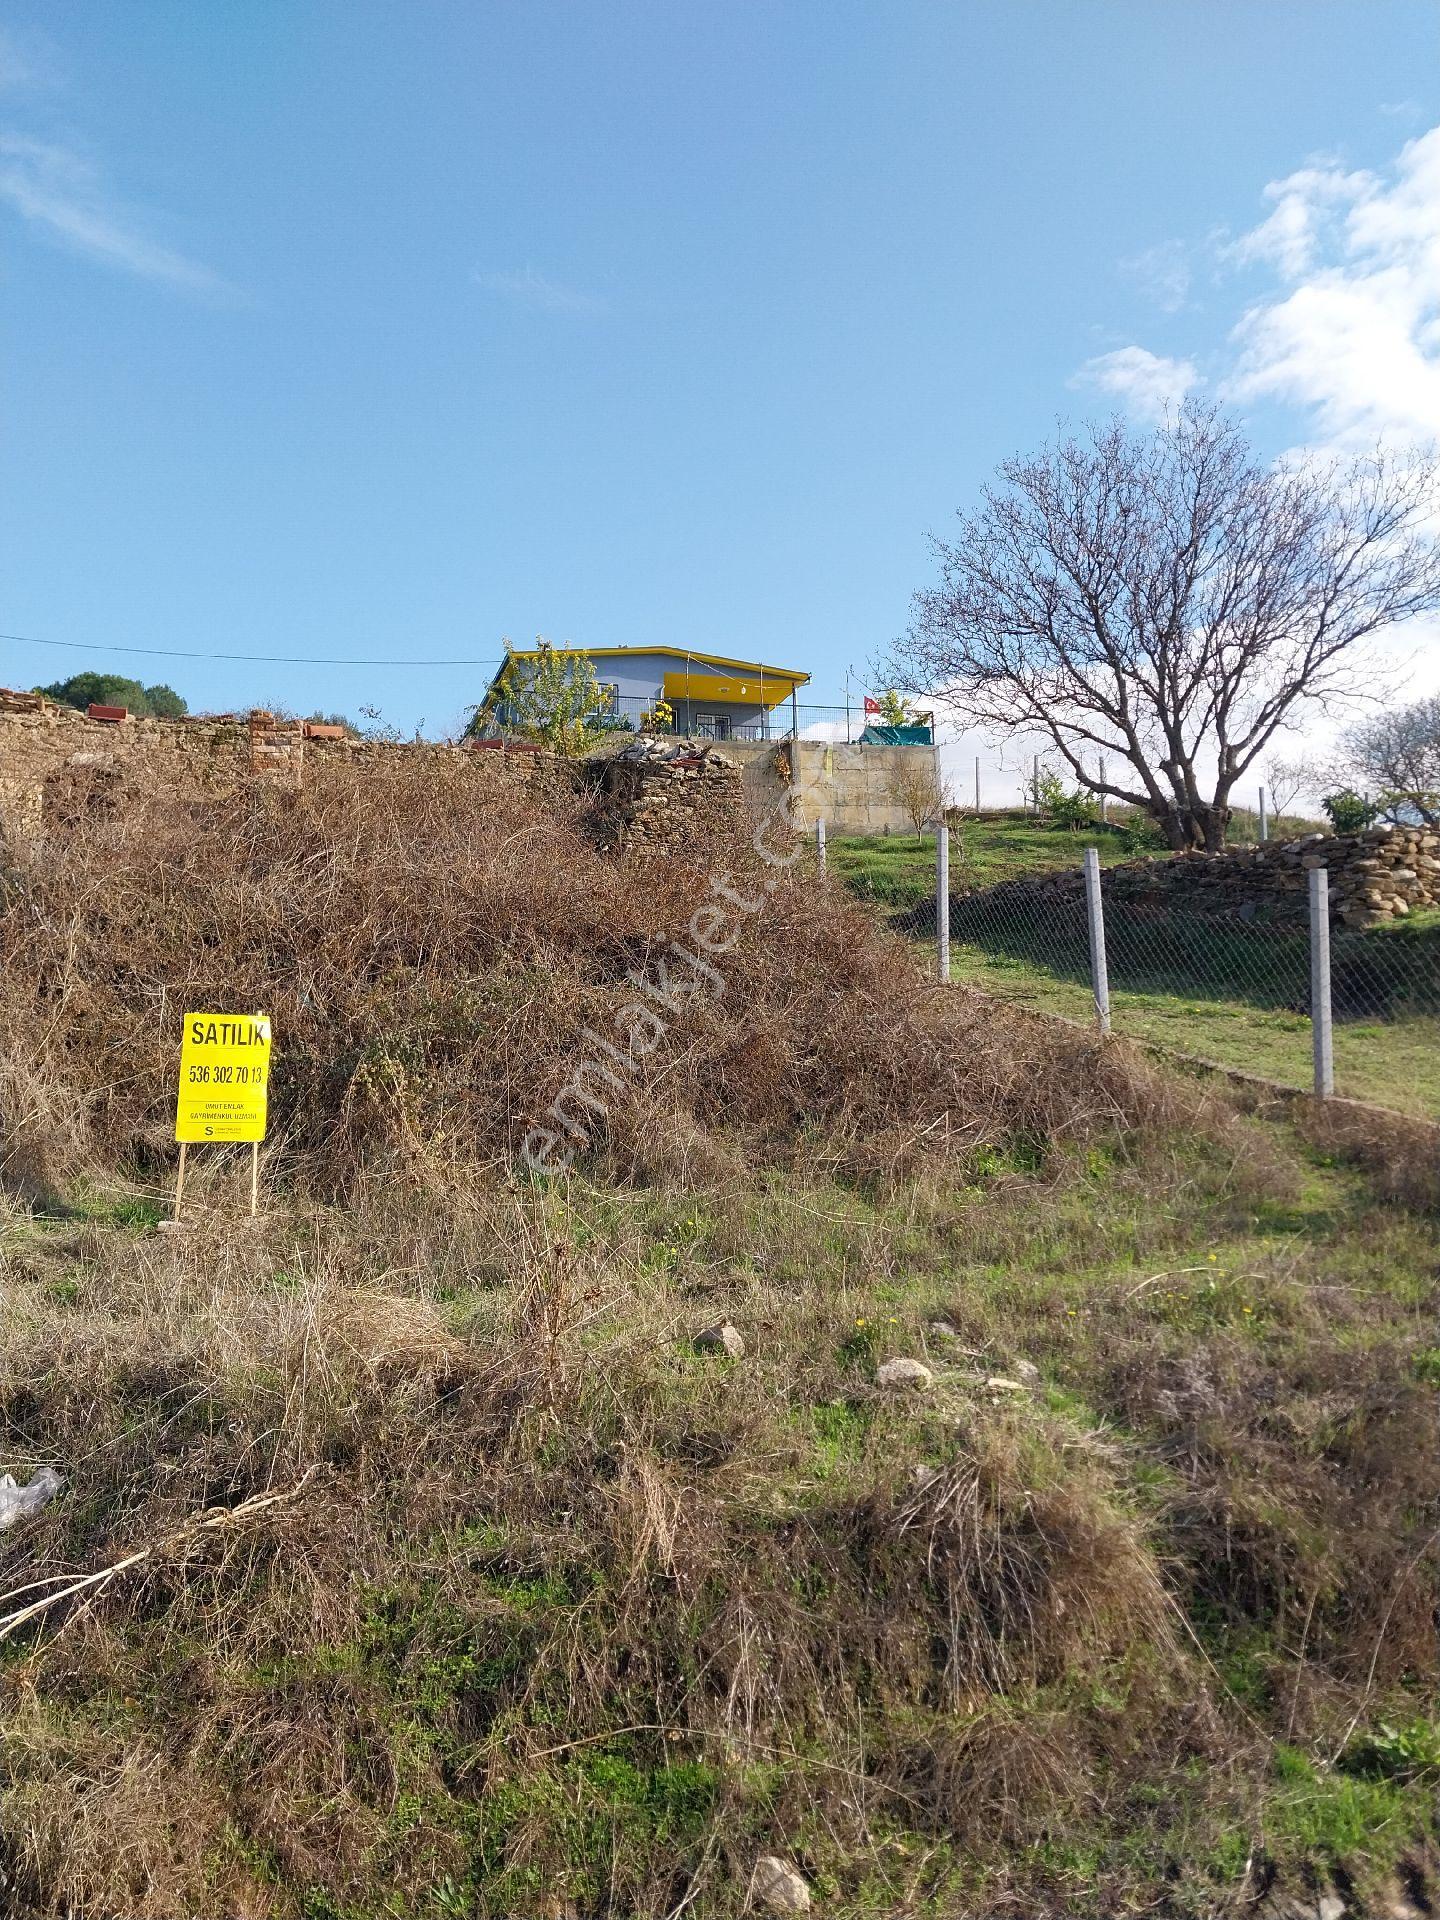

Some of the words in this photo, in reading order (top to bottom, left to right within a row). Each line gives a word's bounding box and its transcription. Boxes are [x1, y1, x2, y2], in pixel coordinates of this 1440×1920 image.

[191, 1022, 265, 1046] SATILIK
[189, 1065, 210, 1083] 536
[213, 1066, 233, 1083] 302
[236, 1066, 249, 1084] 70
[251, 1067, 262, 1084] 13
